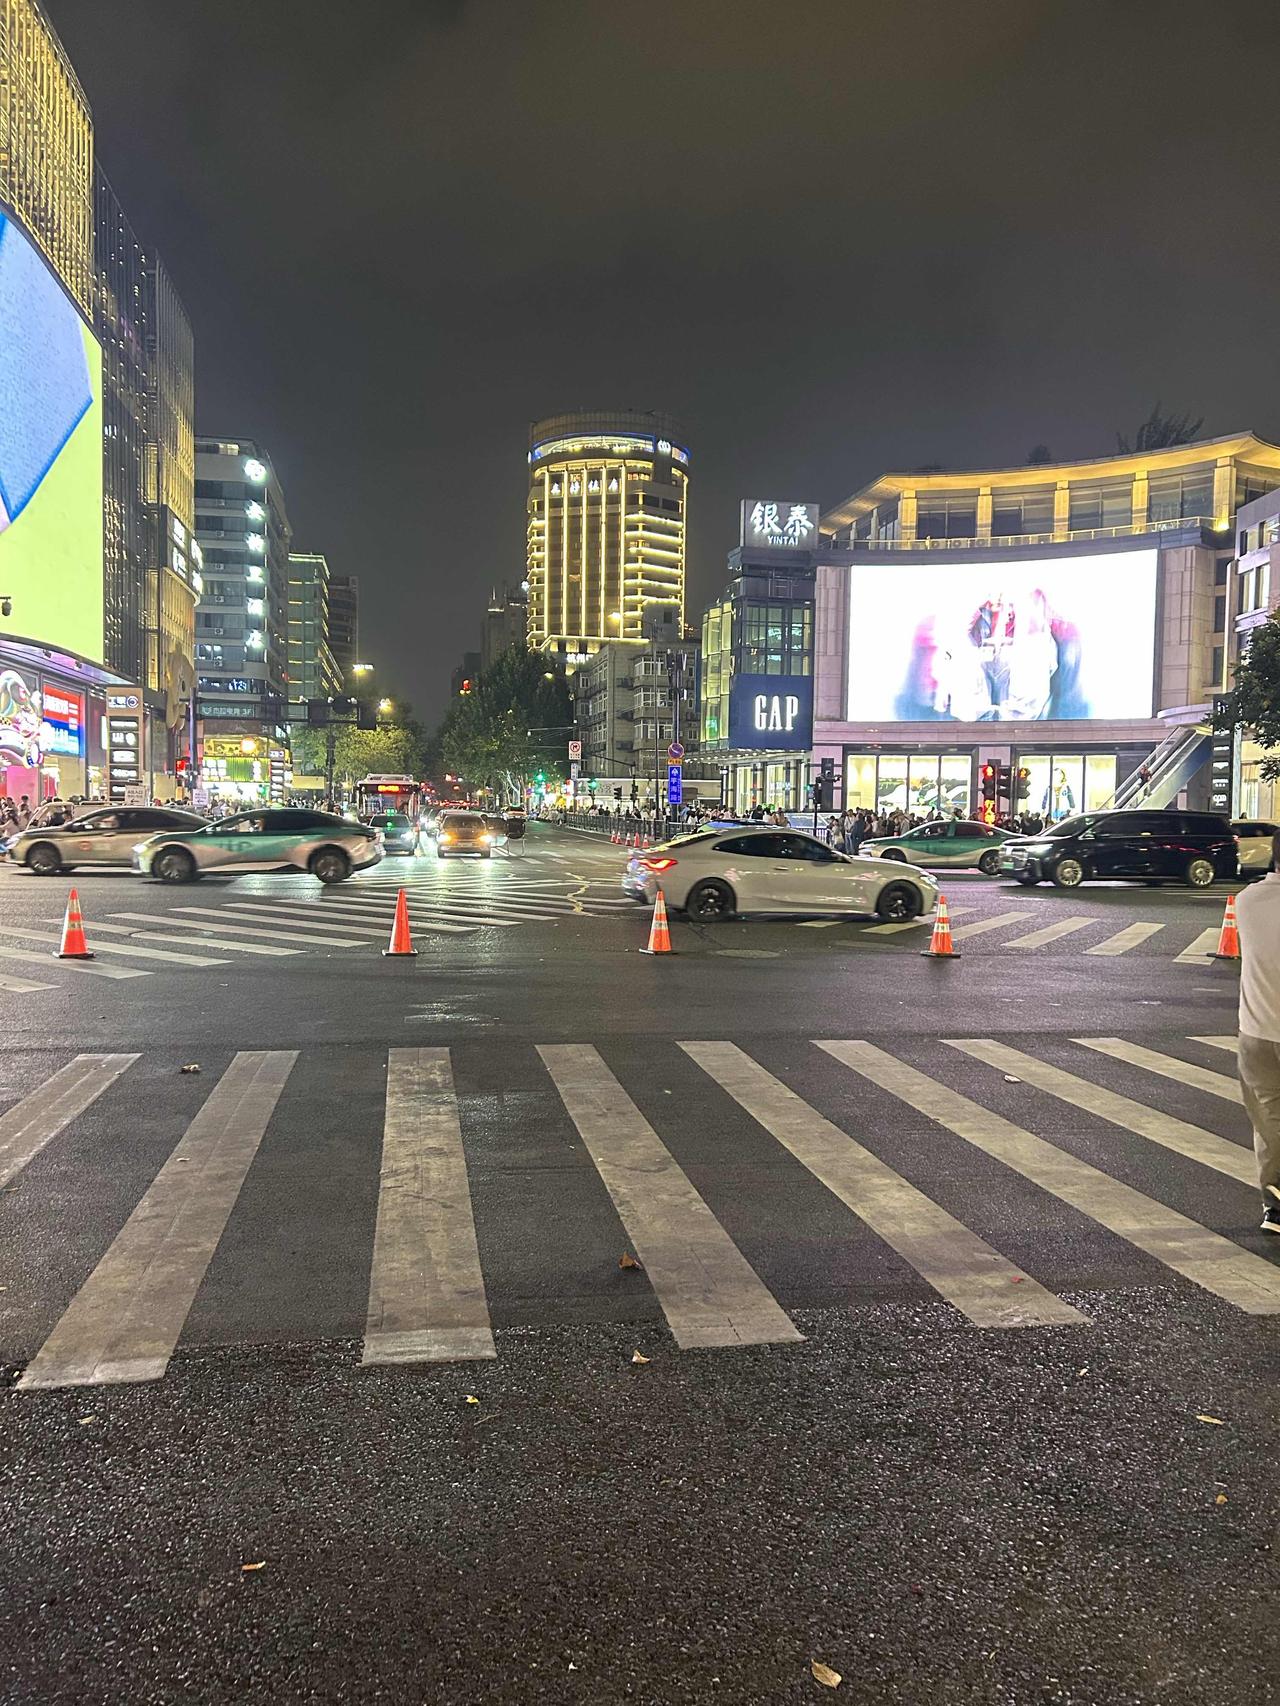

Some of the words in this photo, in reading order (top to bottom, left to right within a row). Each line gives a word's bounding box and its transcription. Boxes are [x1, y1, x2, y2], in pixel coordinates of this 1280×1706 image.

[750, 501, 815, 537] 银泰
[767, 534, 799, 546] YINTAI
[754, 693, 799, 731] GAP
